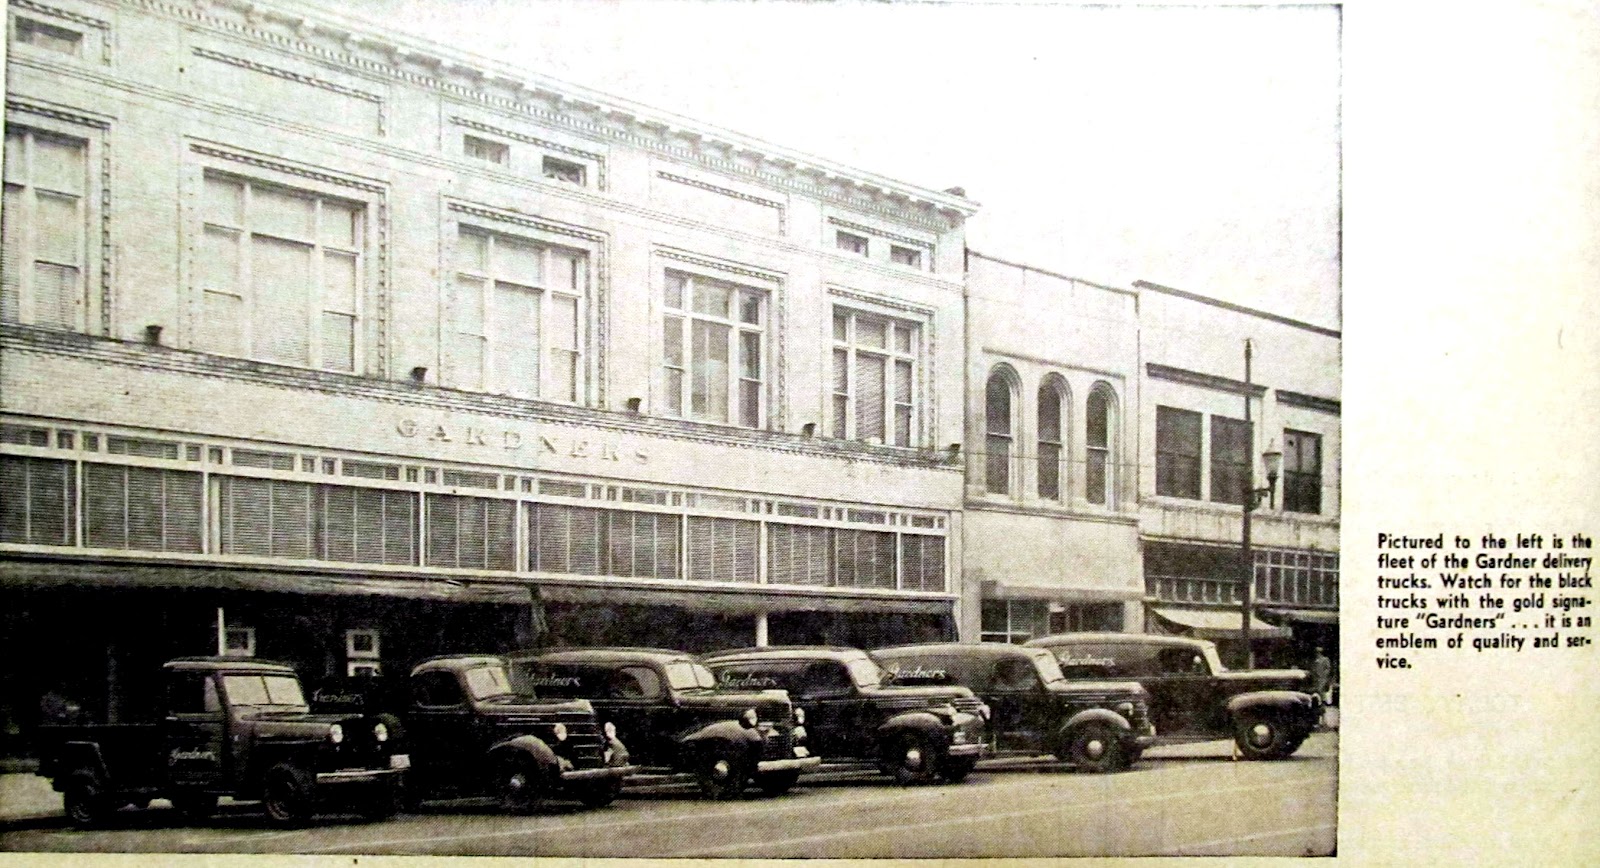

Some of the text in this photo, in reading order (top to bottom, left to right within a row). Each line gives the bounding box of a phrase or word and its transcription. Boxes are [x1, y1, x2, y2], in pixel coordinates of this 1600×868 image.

[396, 418, 650, 465] GARDNERS
[1378, 533, 1592, 549] Pictured to the left is the
[1378, 552, 1593, 572] fleet of the Gardner delivery
[1378, 573, 1593, 588] trucks. Watch for the black
[1378, 593, 1592, 612] trucks with the gold signa-
[1377, 615, 1409, 629] ture
[1545, 613, 1556, 628] it
[1562, 613, 1572, 628] is
[1577, 616, 1591, 628] an
[1376, 633, 1592, 652] emblem of quality and ser-
[1376, 653, 1412, 669] vice.
